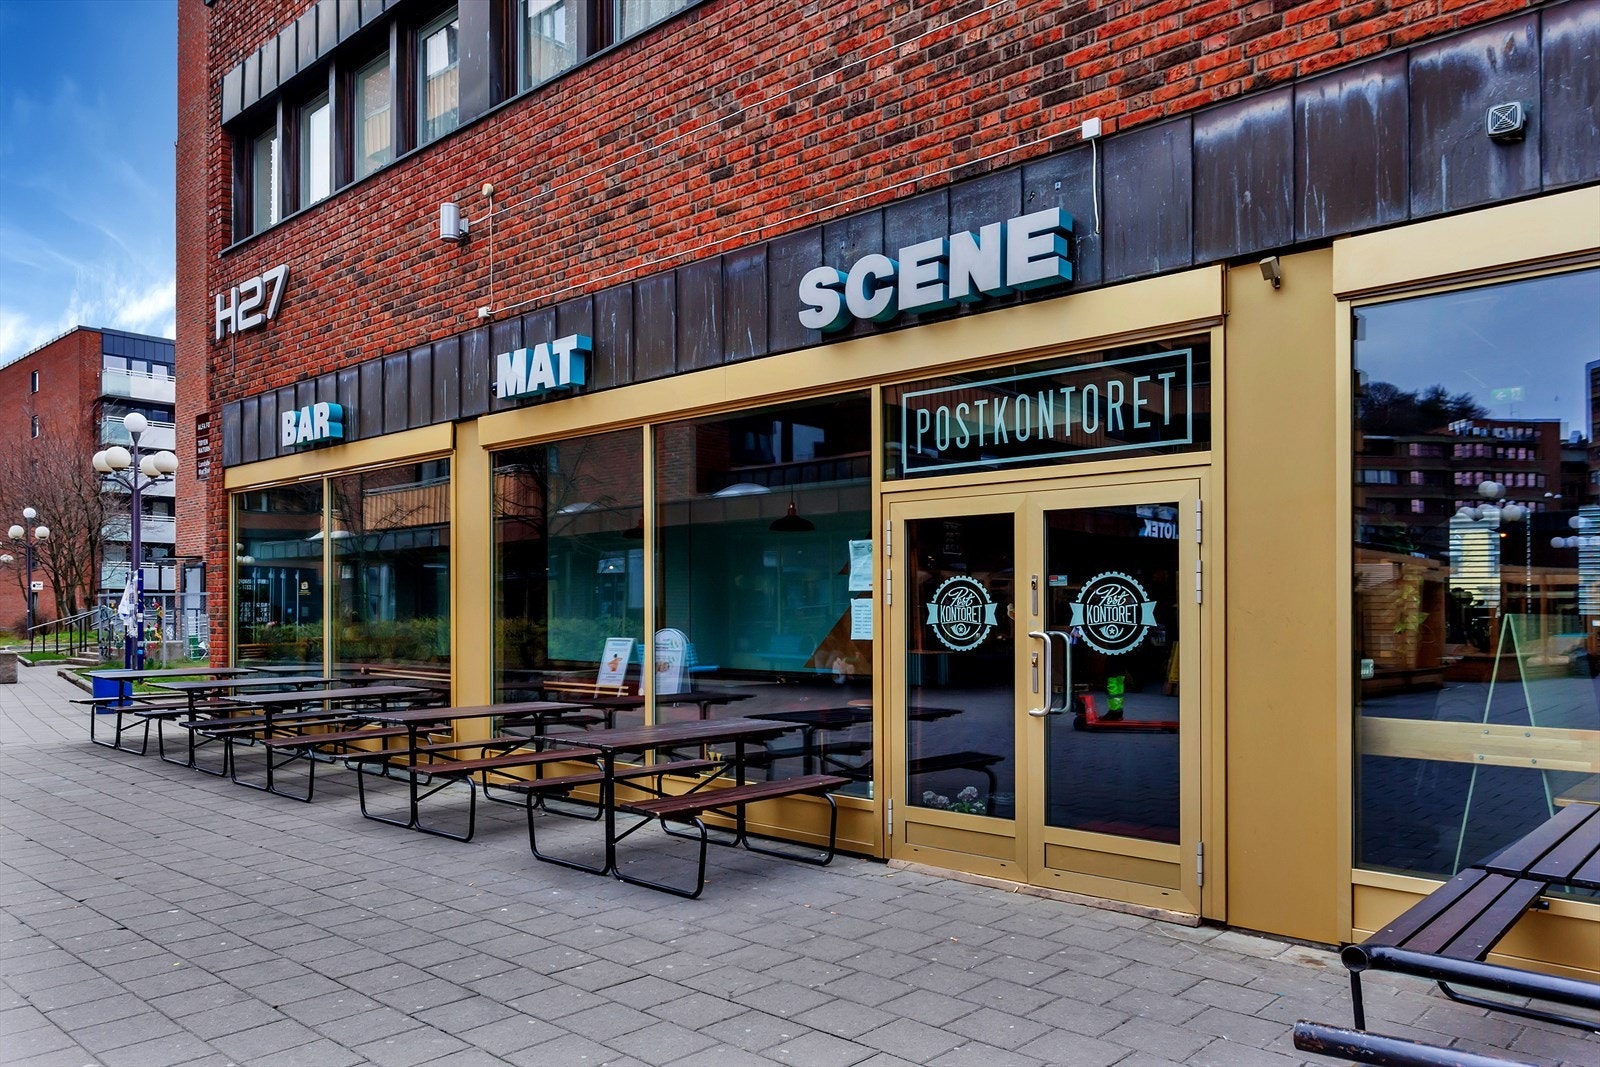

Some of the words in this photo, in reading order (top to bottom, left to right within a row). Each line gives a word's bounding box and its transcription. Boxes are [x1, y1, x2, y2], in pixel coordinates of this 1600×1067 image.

[798, 207, 1073, 334] SCENE
[215, 264, 289, 340] H27
[497, 334, 592, 399] MAT
[282, 402, 343, 447] BAR
[916, 371, 1176, 455] POSTKONTORET
[940, 604, 983, 624] KONTORET
[948, 586, 976, 607] Post
[1087, 604, 1138, 625] KONTORET
[1096, 583, 1130, 606] Post
